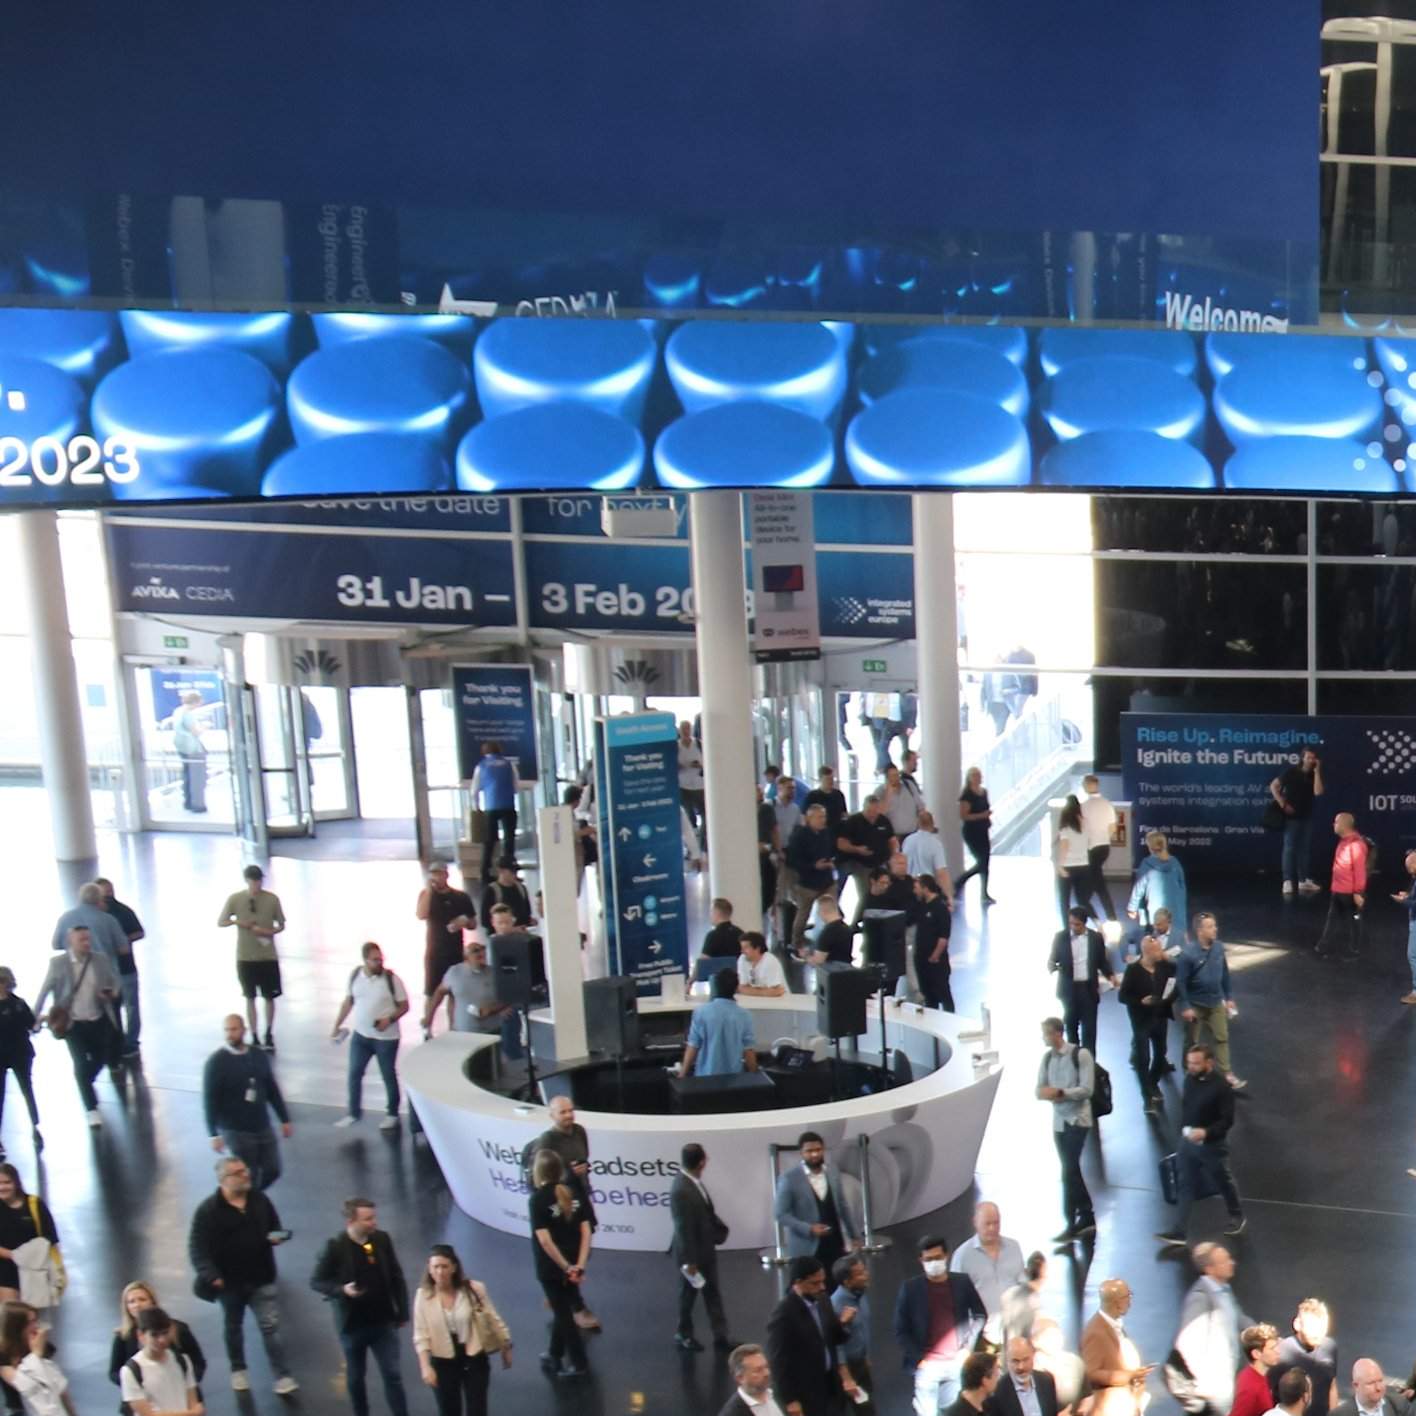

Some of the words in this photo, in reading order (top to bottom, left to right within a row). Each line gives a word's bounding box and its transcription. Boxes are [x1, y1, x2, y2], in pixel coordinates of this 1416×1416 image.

[0, 435, 140, 485] 2023
[336, 574, 390, 608] 31
[394, 576, 474, 611] Jan
[541, 583, 569, 615] 3
[575, 584, 645, 617] Feb
[1136, 726, 1179, 744] Rise
[1183, 728, 1216, 747] Up.
[1219, 728, 1325, 749] Reimagine.
[1136, 747, 1193, 768] Ignite
[1196, 749, 1230, 764] the
[1369, 795, 1399, 811] IOT
